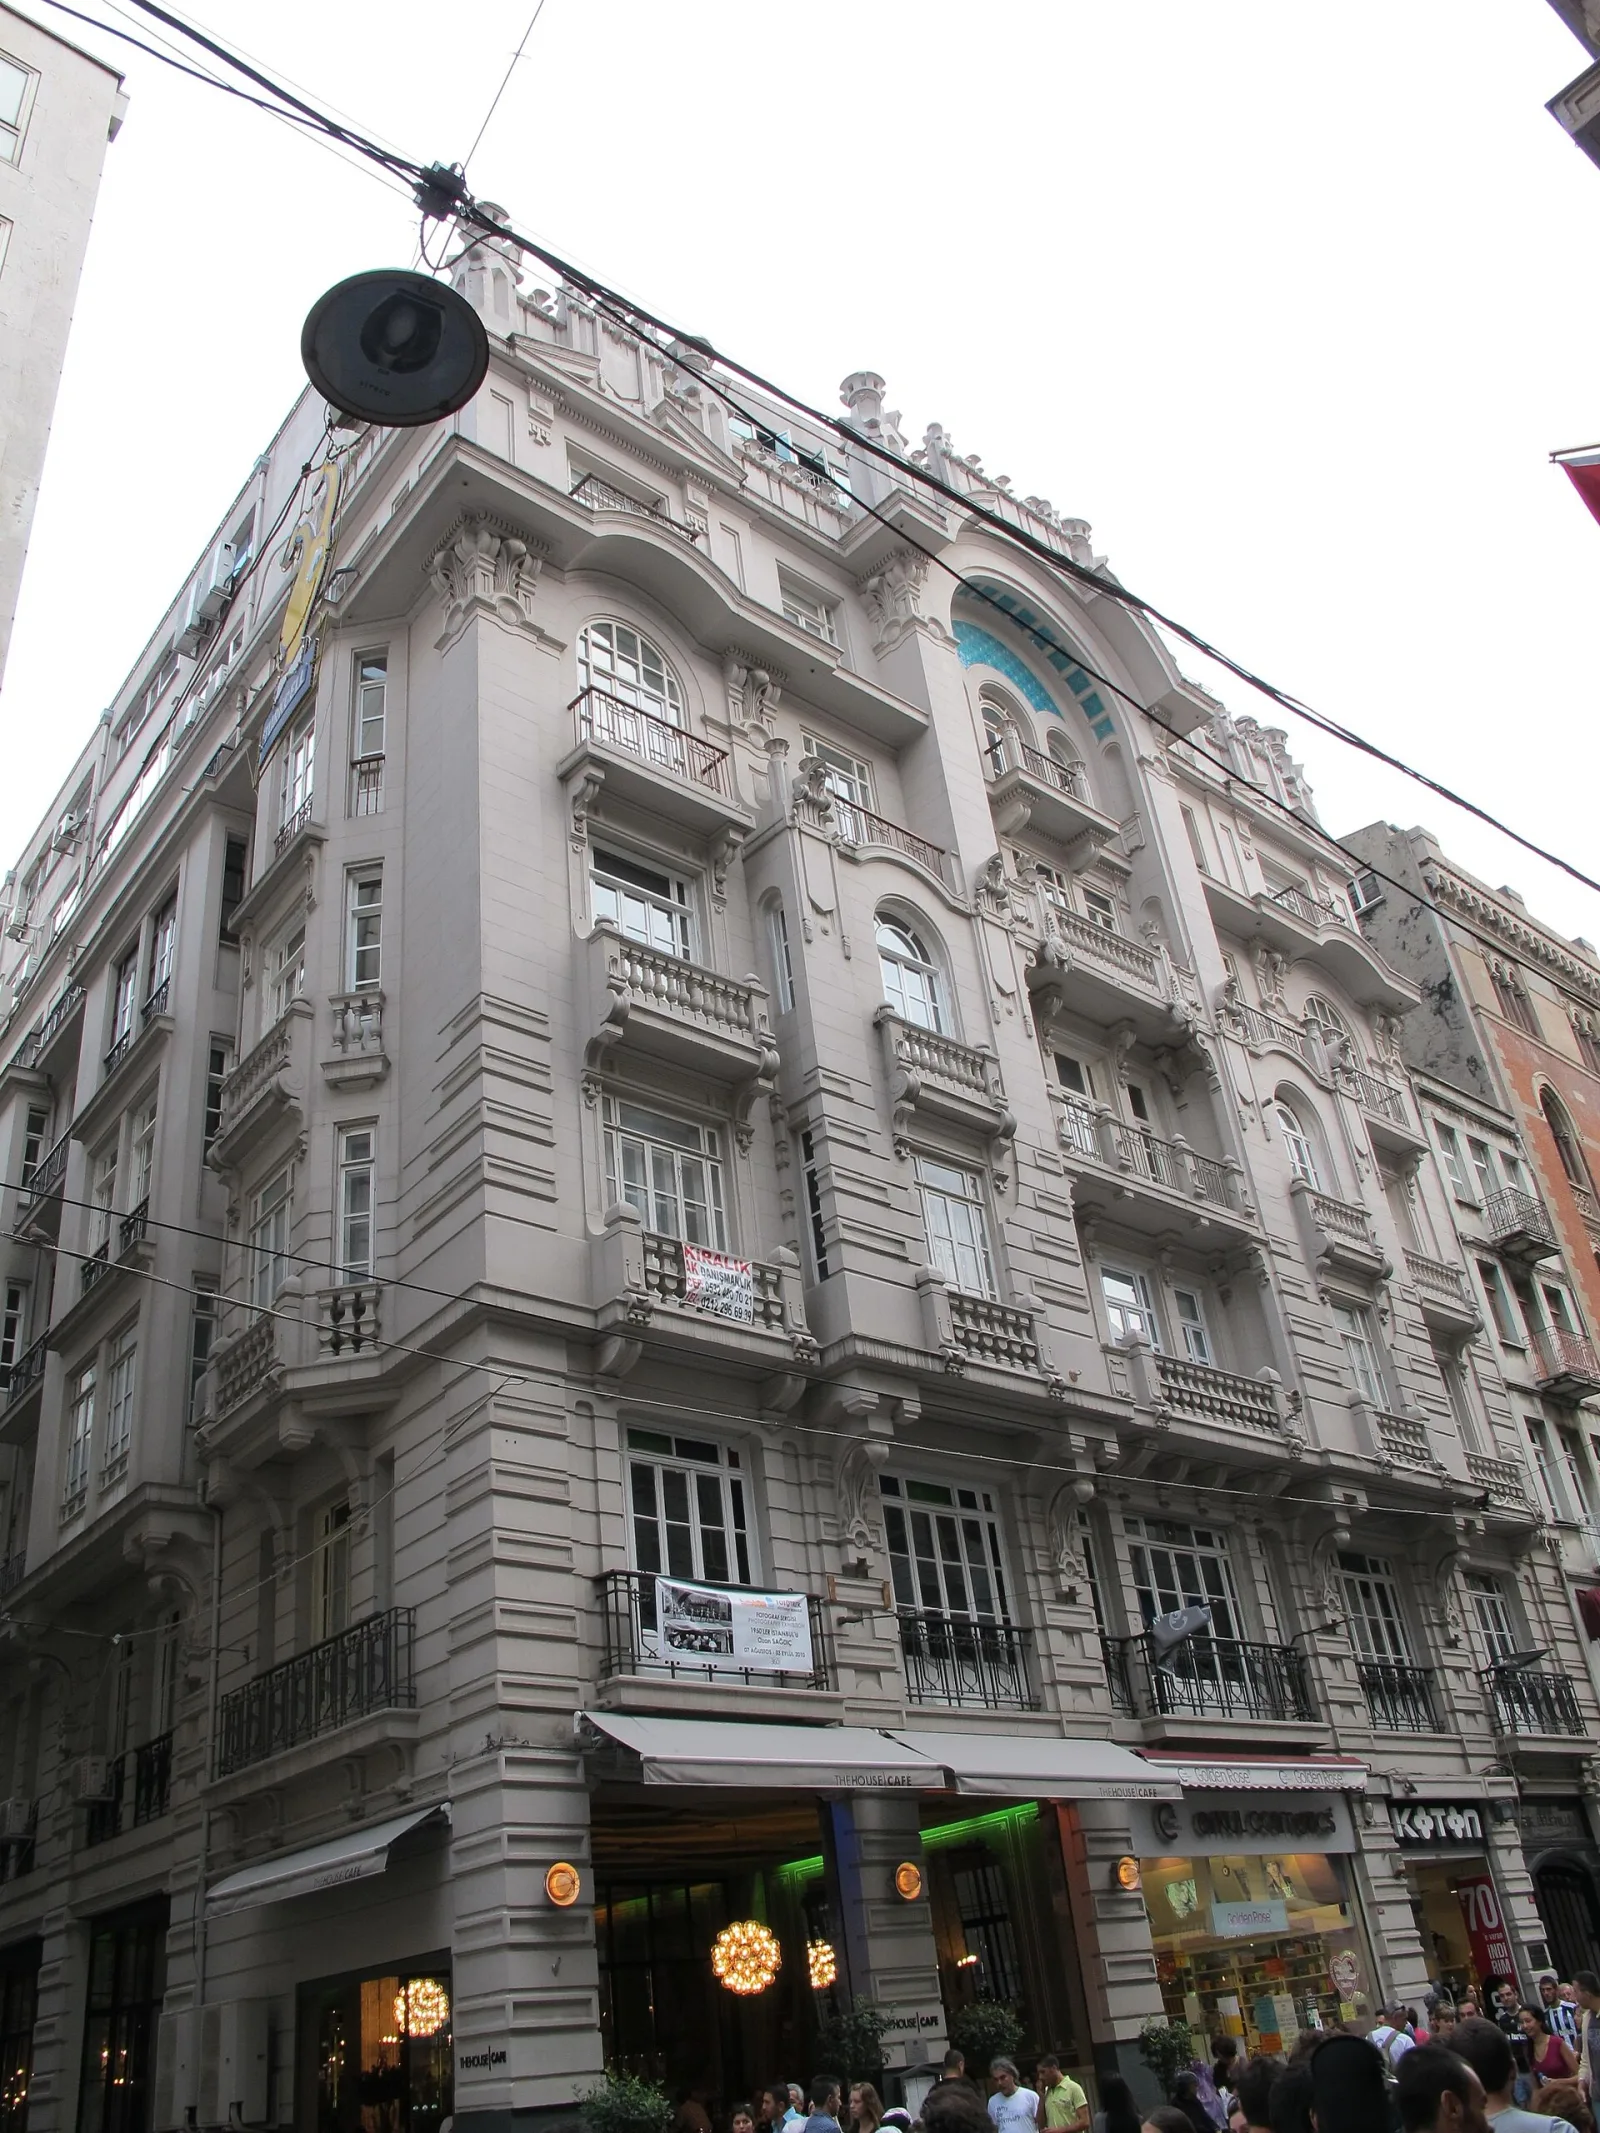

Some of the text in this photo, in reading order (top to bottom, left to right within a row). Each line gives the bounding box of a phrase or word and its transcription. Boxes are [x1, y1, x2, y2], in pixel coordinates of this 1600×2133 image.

[686, 1259, 699, 1276] AK
[705, 1282, 721, 1296] 0532
[736, 1291, 743, 1303] 70
[744, 1294, 752, 1306] 21
[701, 1296, 718, 1311] 0212
[720, 1302, 732, 1316] 296
[734, 1306, 743, 1318] 69
[744, 1309, 752, 1322] 39
[1195, 1768, 1250, 1784] Golden Rose
[1294, 1770, 1344, 1785] Golden Rose
[1392, 1806, 1482, 1840] KOTON
[1228, 1911, 1271, 1924] Golden Rose
